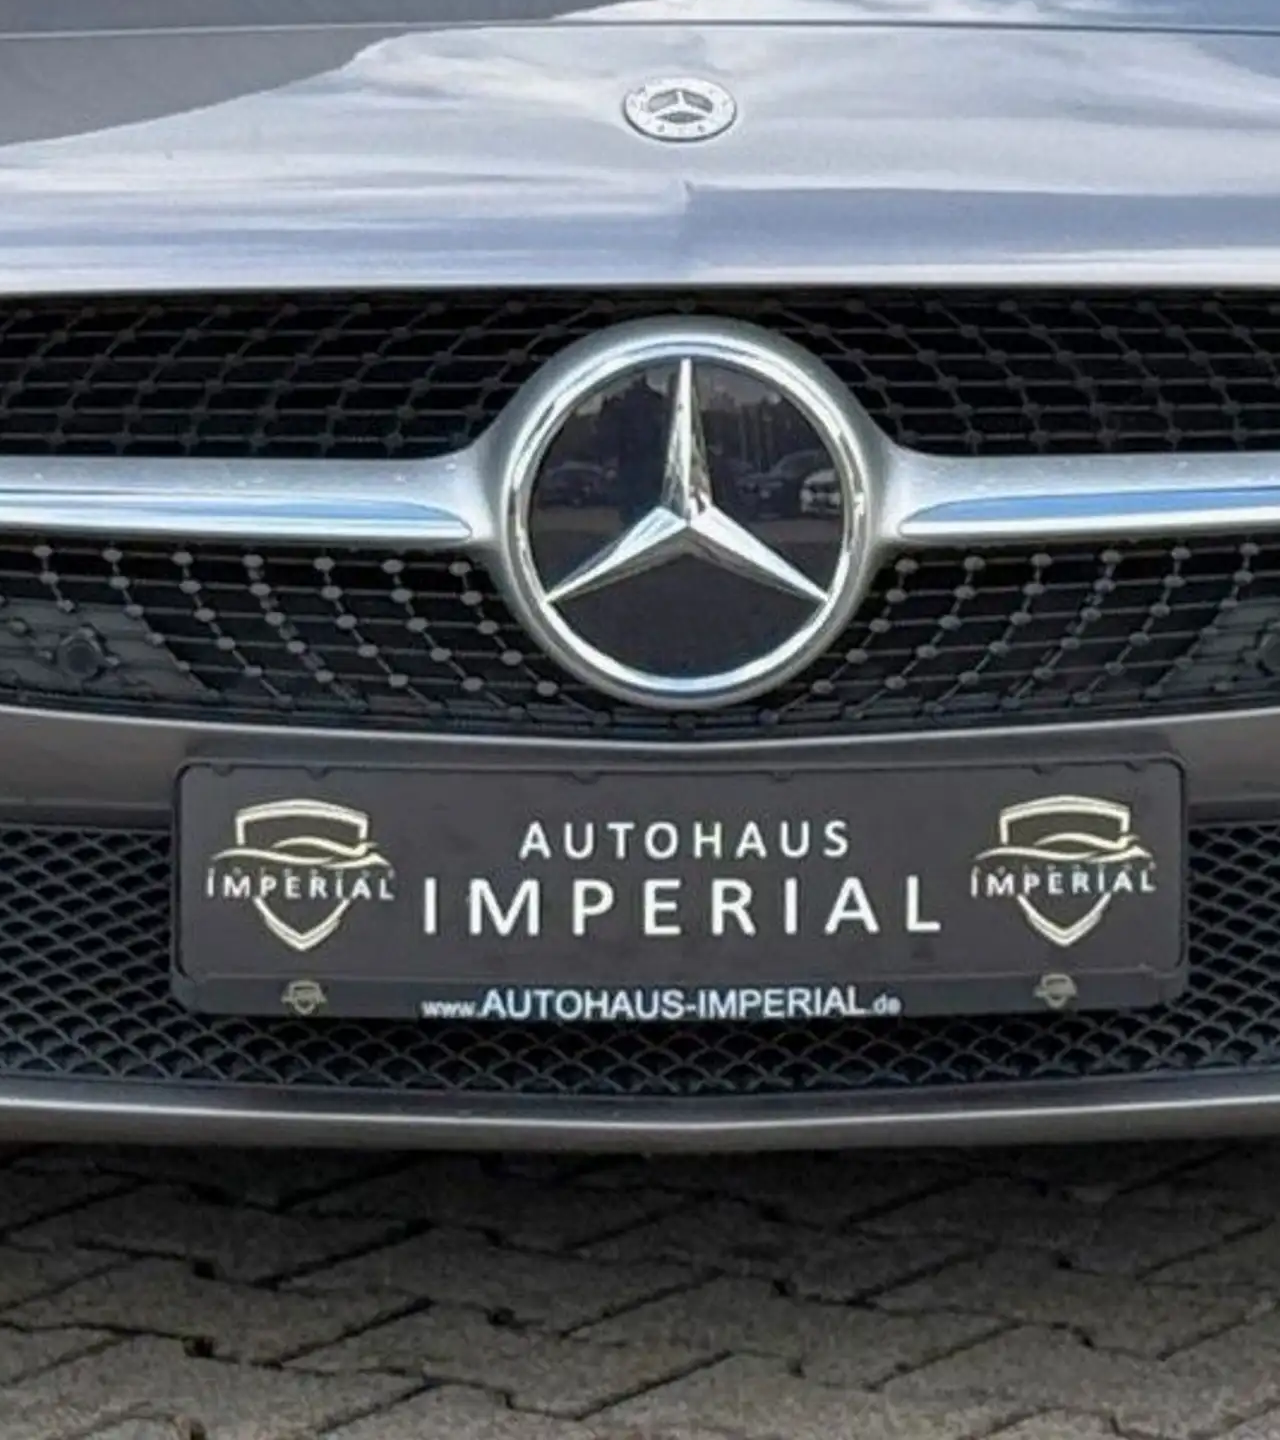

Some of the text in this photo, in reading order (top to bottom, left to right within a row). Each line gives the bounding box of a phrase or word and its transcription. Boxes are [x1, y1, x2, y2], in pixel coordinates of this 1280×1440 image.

[520, 820, 851, 859] AUTOHAUS
[205, 870, 395, 901] IMPERIAL
[970, 866, 1158, 898] IMPERIAL
[423, 874, 942, 936] IMPERIAL
[421, 986, 902, 1021] www.AUTOHAUS-IMPERIAL.de
